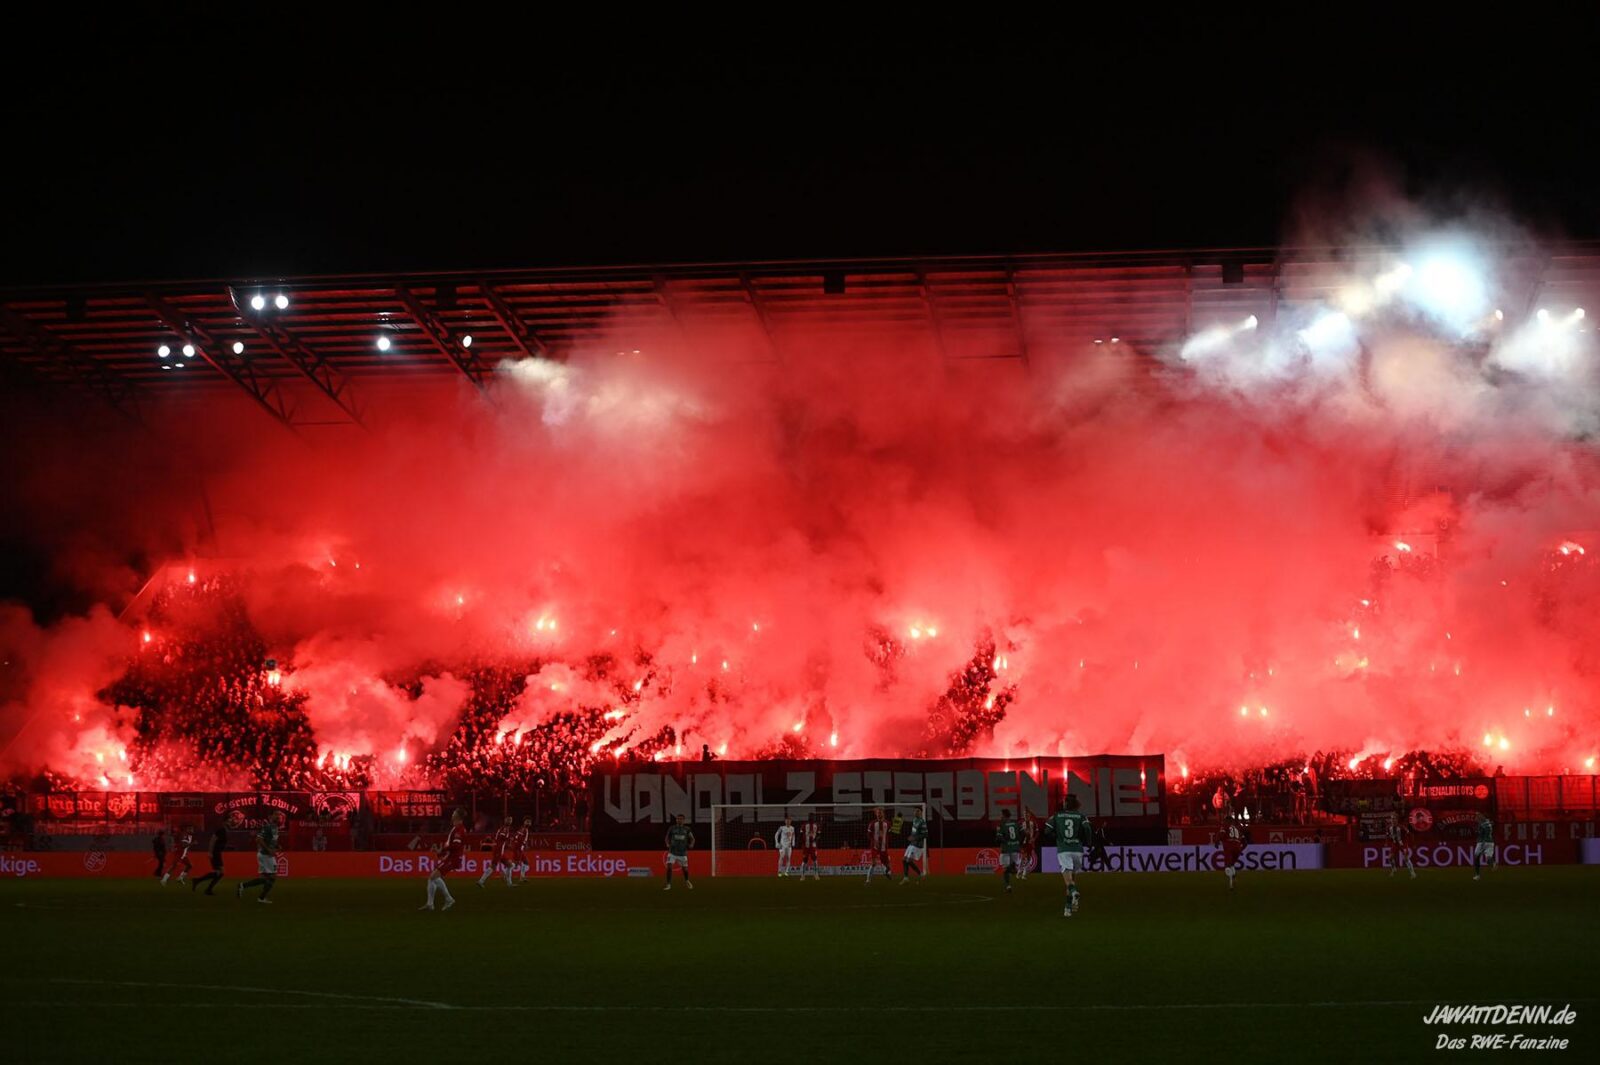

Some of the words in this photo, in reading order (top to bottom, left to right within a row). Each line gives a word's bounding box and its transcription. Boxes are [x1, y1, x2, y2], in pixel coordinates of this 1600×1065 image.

[832, 769, 1050, 823] STERBEN
[1066, 766, 1160, 818] NIE!
[1009, 826, 1016, 840] 8
[1064, 818, 1074, 839] 3
[379, 856, 413, 873] Das
[535, 855, 561, 873] ins
[567, 855, 631, 877] Eckige.
[1080, 846, 1297, 872] tadtwerkessen
